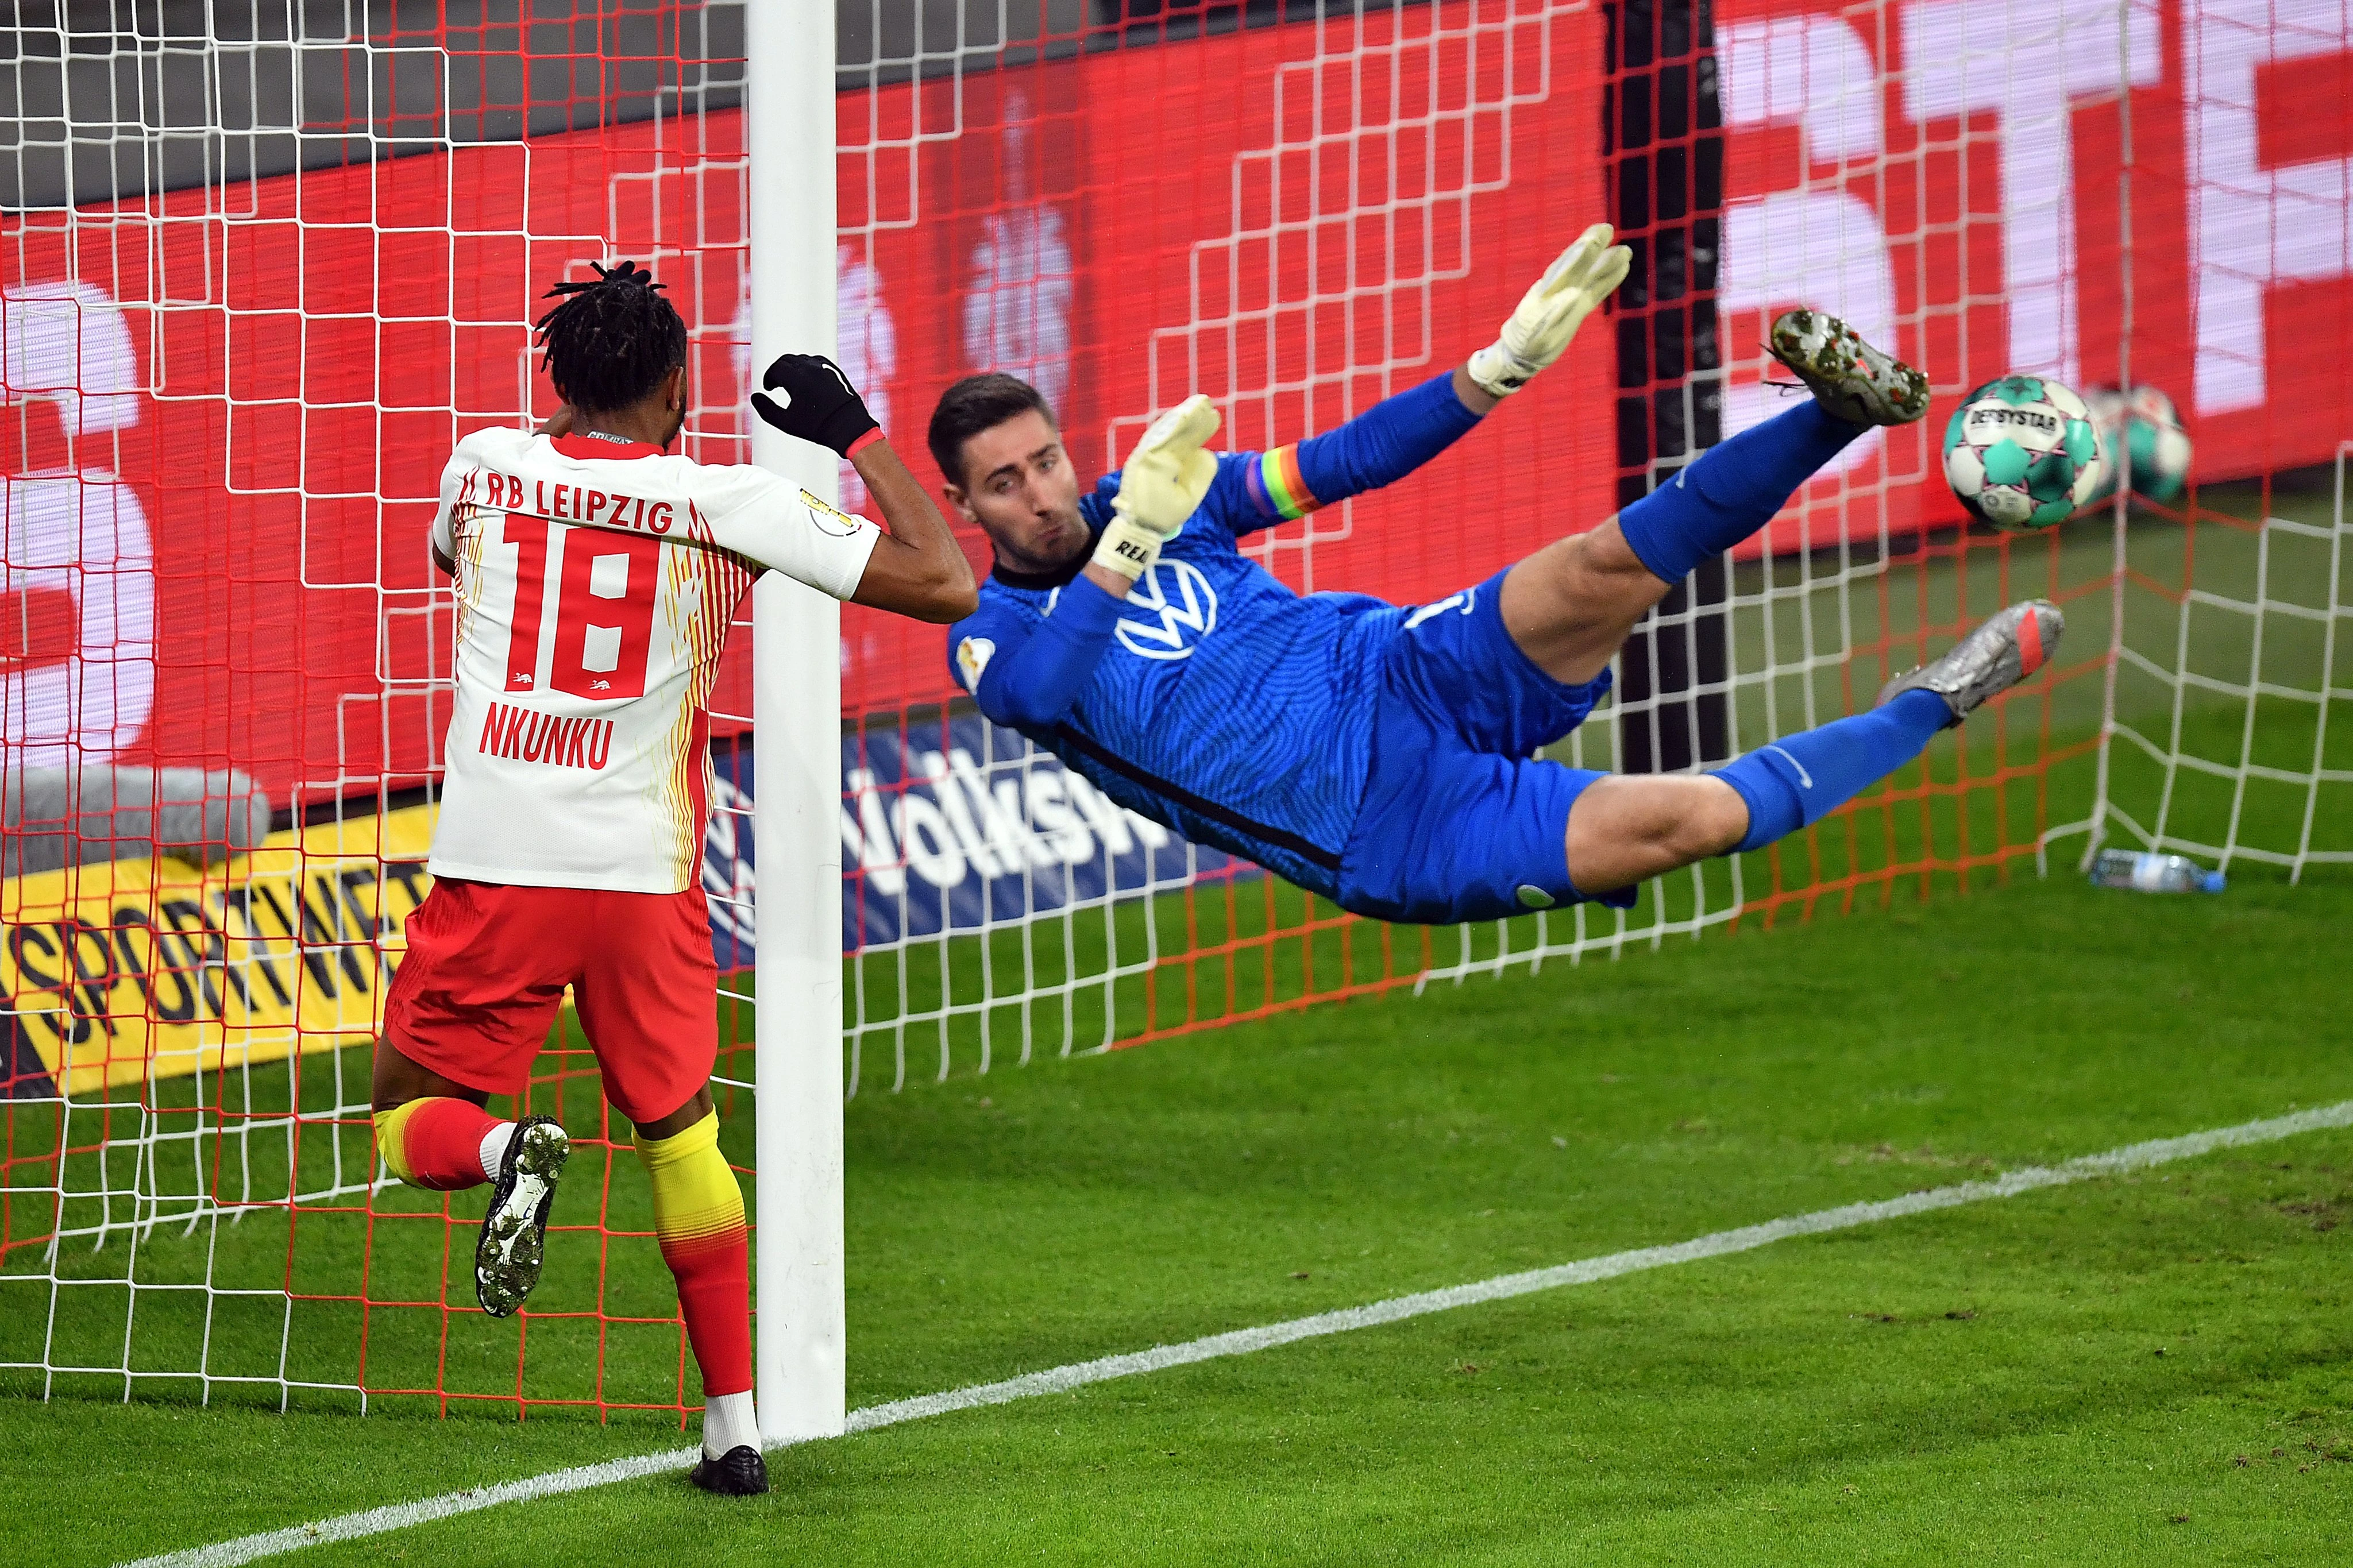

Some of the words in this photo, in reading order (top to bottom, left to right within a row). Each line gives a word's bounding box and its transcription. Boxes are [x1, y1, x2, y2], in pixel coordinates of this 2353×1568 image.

[486, 472, 523, 509] RB
[536, 479, 673, 535] LEIPZIG
[503, 512, 662, 701] 18
[479, 702, 614, 770] NKUNKU
